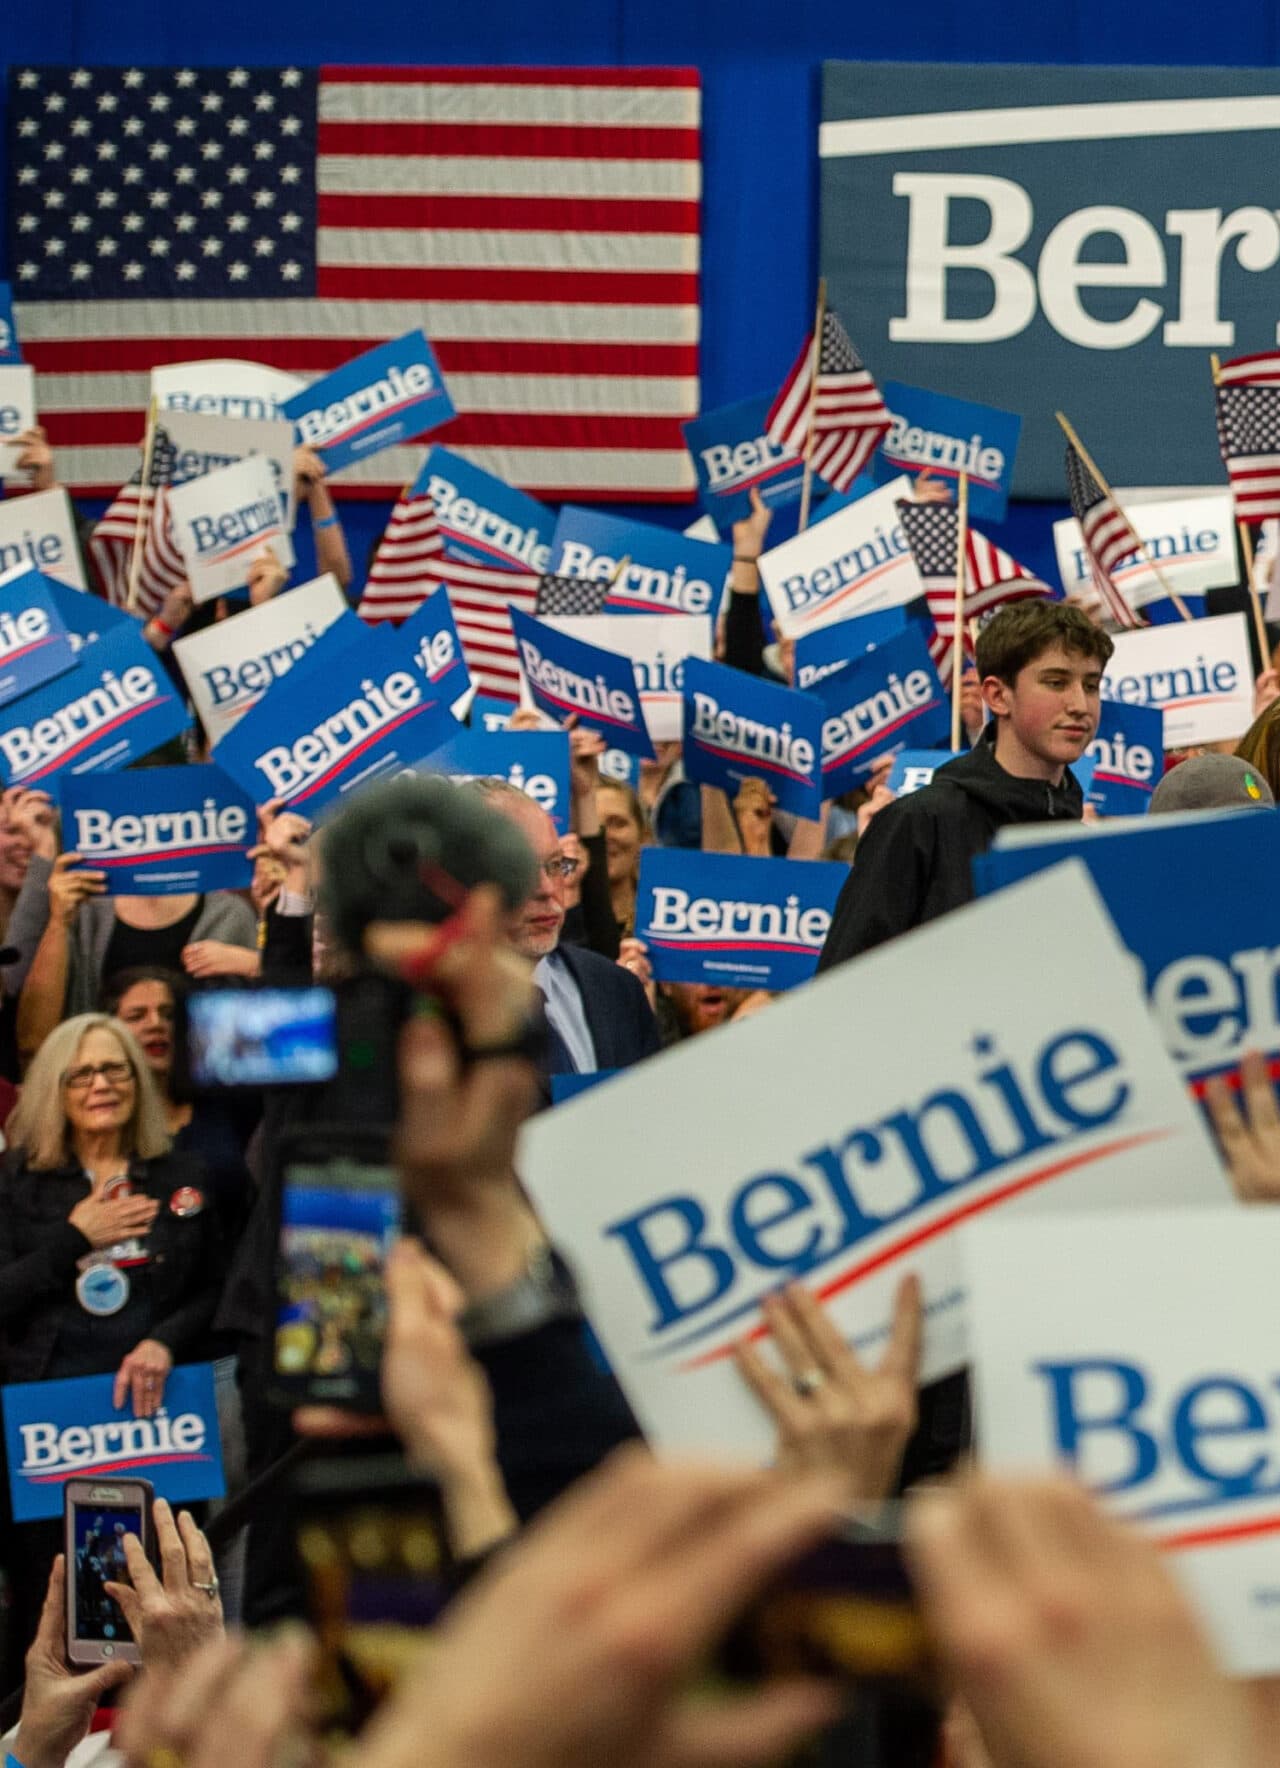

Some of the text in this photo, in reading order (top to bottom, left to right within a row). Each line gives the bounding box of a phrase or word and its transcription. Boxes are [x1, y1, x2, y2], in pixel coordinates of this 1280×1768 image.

[167, 391, 283, 421] Berni
[298, 363, 434, 444] Bernie
[700, 436, 790, 484] Ber
[884, 415, 1005, 481] Bernie
[0, 530, 62, 572] nie
[189, 494, 283, 554] Bernie
[427, 475, 551, 574] Bernie
[559, 541, 713, 613] Bernie
[780, 526, 911, 612] Bernie
[203, 622, 317, 705] Bern
[519, 638, 636, 724] Bernie
[1, 658, 158, 775] Bernie
[254, 669, 422, 798] Bernie
[693, 692, 815, 776] Bernie
[821, 669, 933, 754] ernie
[1085, 732, 1154, 781] nie
[74, 800, 248, 851] Bernie
[650, 886, 832, 944] Bernie
[603, 1028, 1130, 1333] Bernie
[19, 1407, 206, 1468] Bernie
